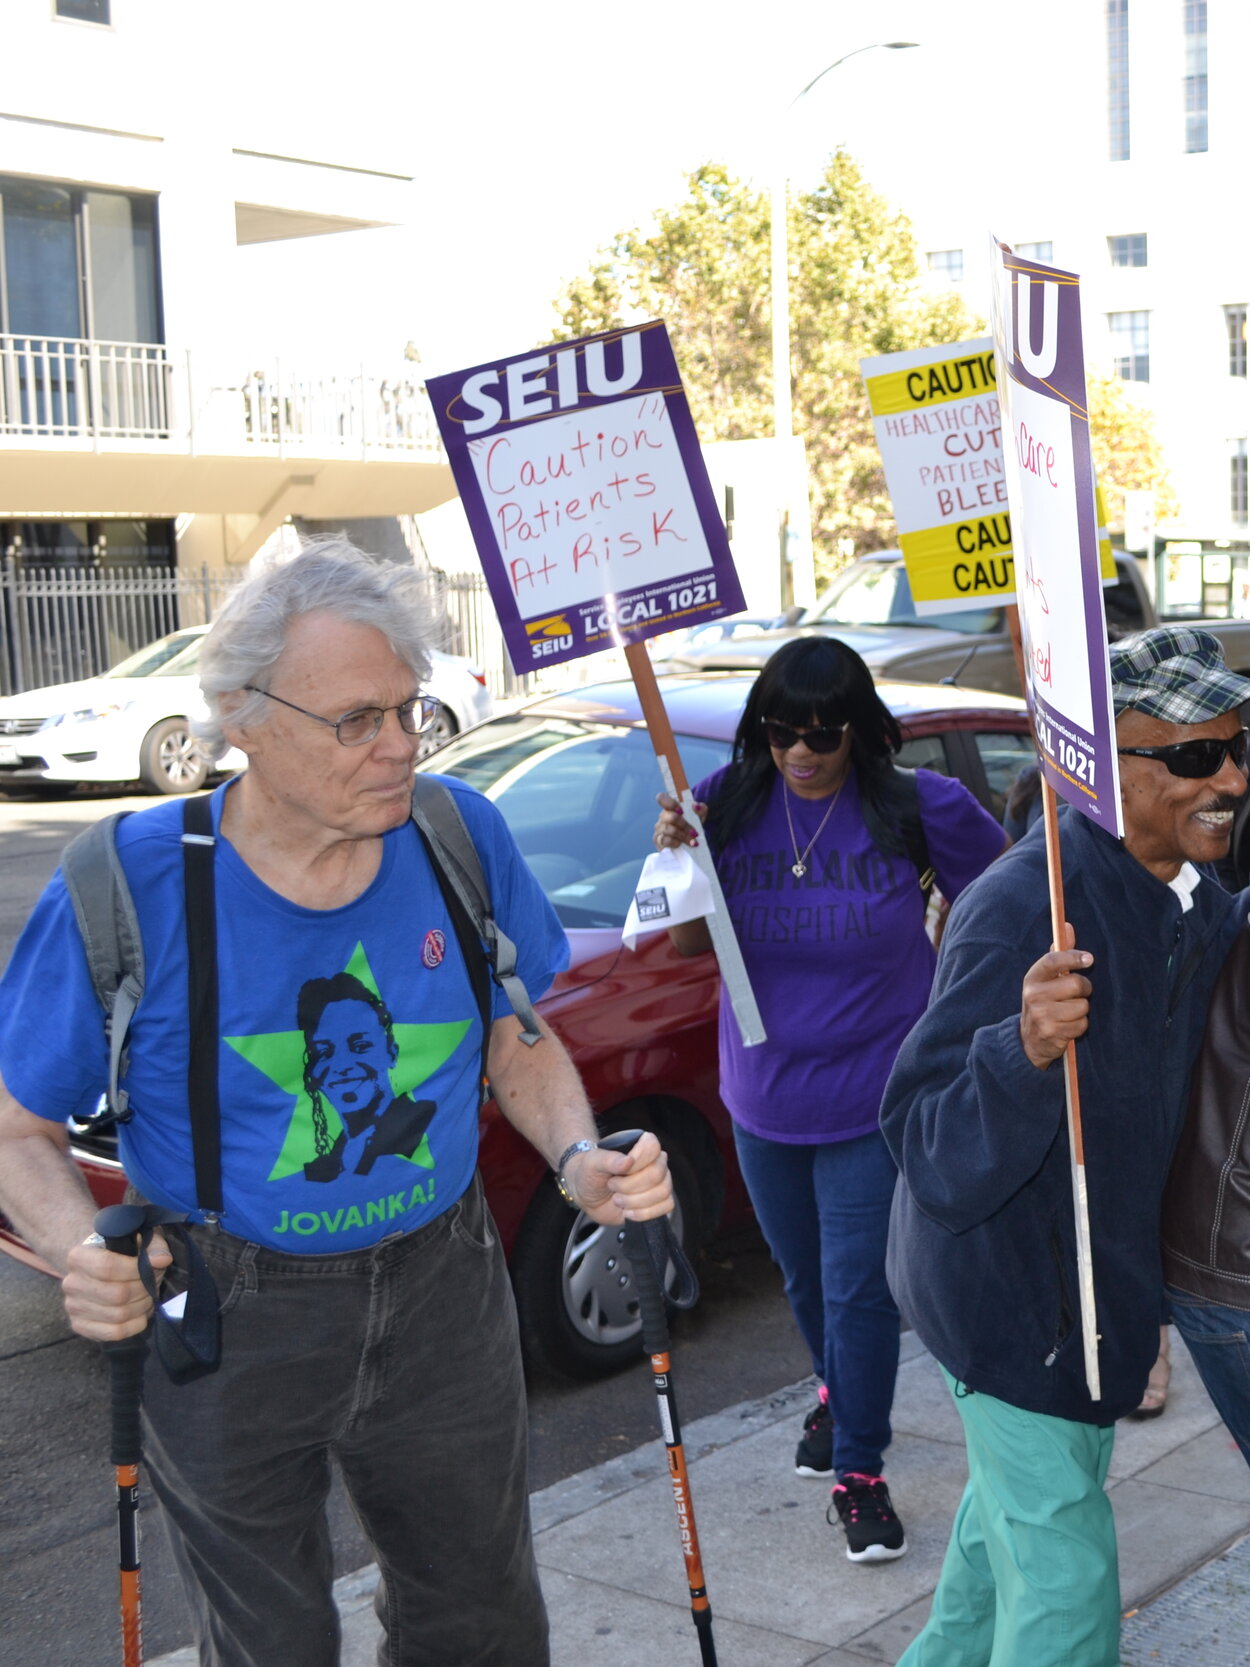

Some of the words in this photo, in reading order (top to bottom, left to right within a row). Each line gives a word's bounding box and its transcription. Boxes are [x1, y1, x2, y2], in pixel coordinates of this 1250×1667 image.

[462, 332, 643, 435] SEIU
[907, 352, 997, 402] CAUTIO
[885, 398, 1000, 438] HEALTHCAR
[920, 455, 1005, 486] PATIEN
[497, 472, 656, 550] Patients
[937, 480, 1009, 517] BLEE
[510, 555, 557, 596] At
[645, 579, 692, 598] International
[692, 573, 716, 585] Union
[584, 598, 663, 635] LOCAL
[668, 581, 717, 611] 1021
[532, 635, 573, 659] SEIU
[1036, 713, 1055, 757] CAL
[1059, 738, 1096, 787] 1021
[1077, 736, 1095, 756] Union
[640, 904, 666, 917] SEIU
[731, 901, 881, 945] HOSPITAL
[273, 1178, 436, 1236] JOVANKA!
